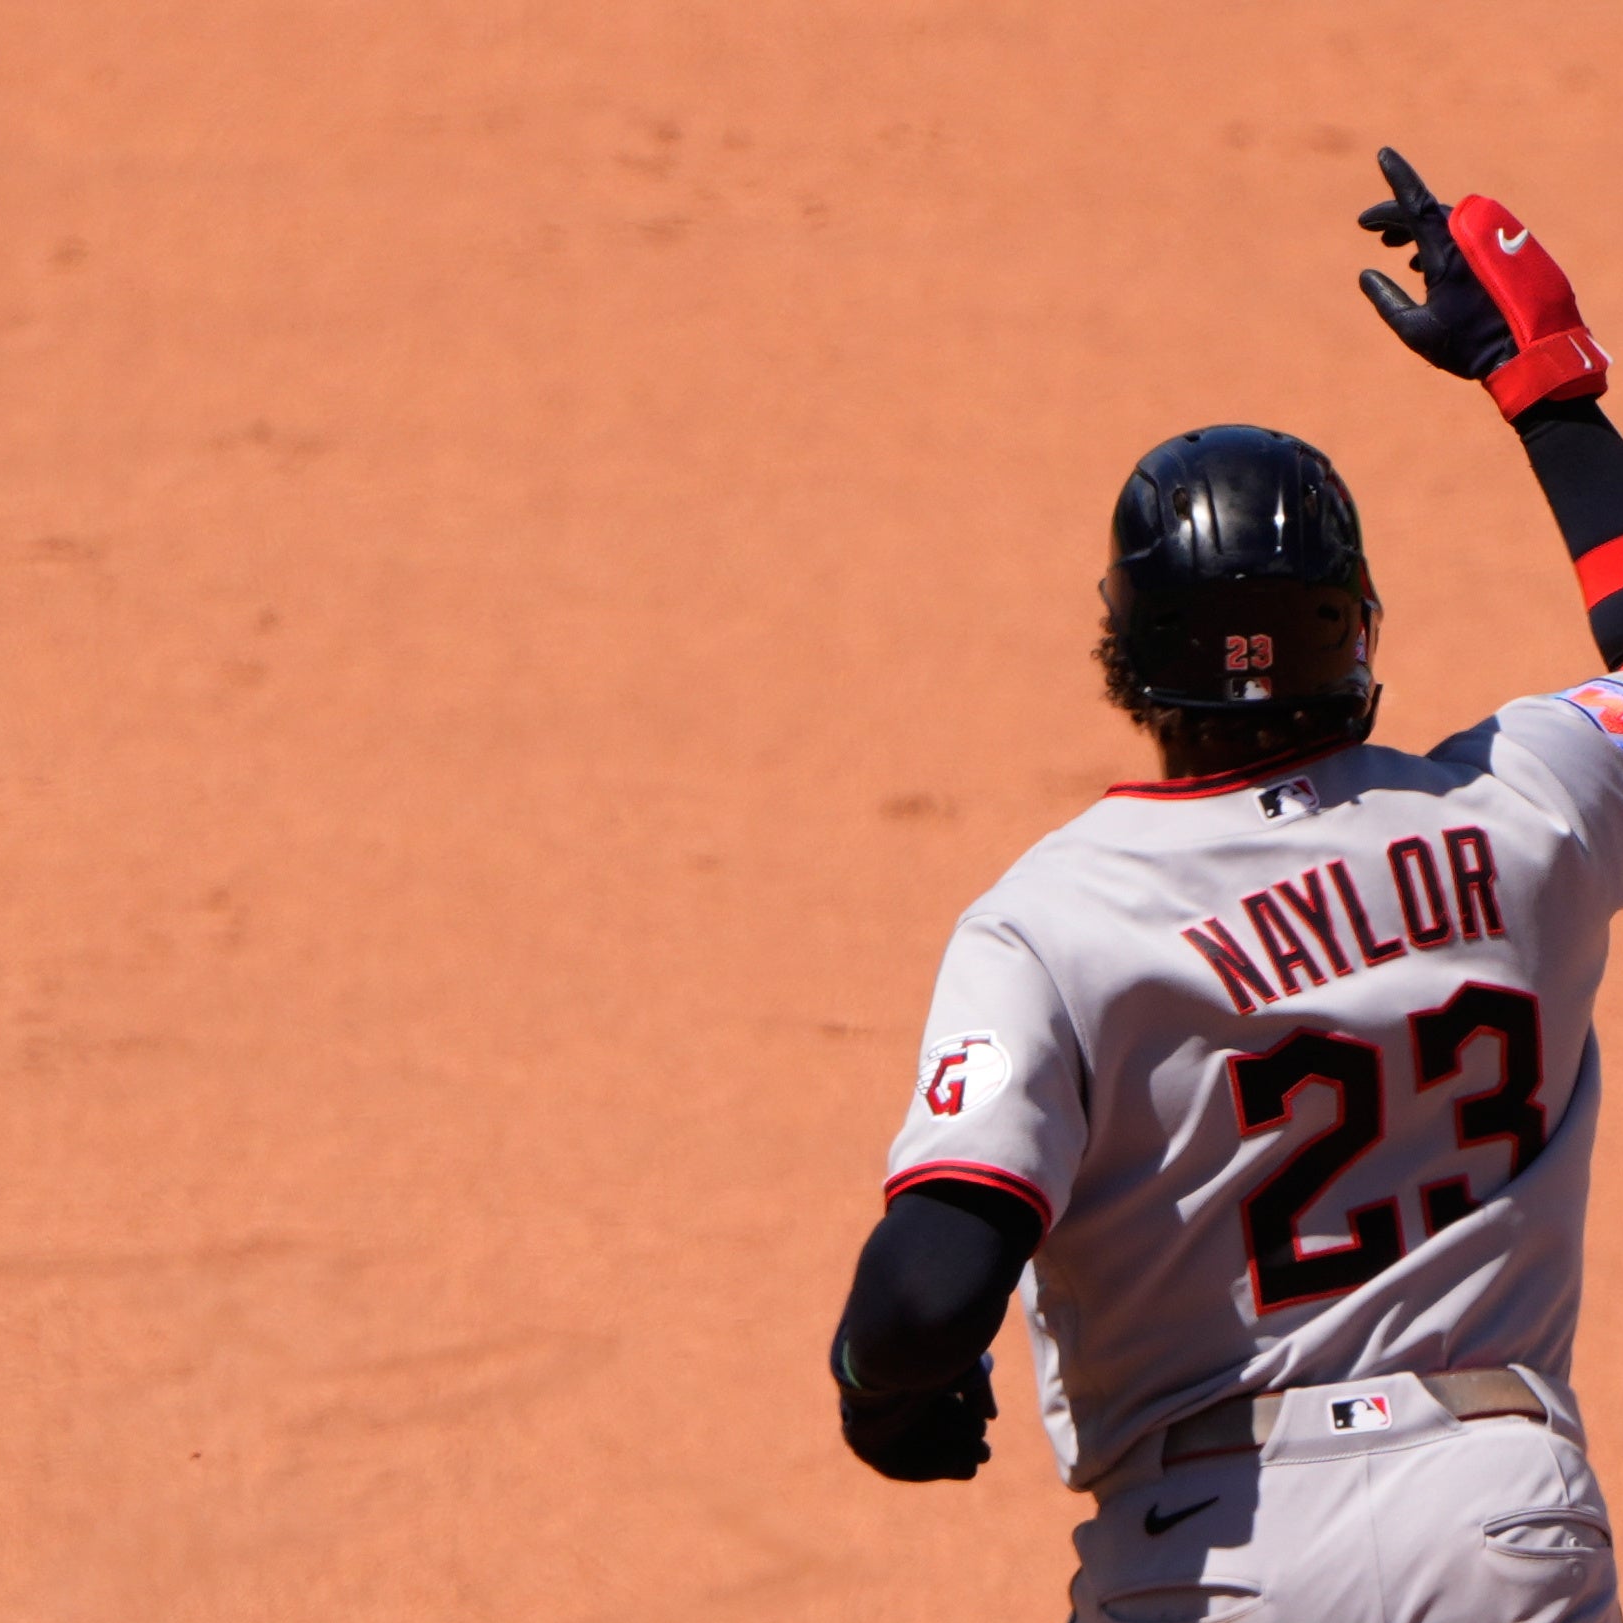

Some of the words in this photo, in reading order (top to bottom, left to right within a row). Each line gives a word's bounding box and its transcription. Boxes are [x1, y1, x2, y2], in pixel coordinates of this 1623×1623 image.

[1225, 634, 1273, 671] 23
[1180, 825, 1506, 1016] NAYLOR
[1226, 980, 1547, 1316] 23
